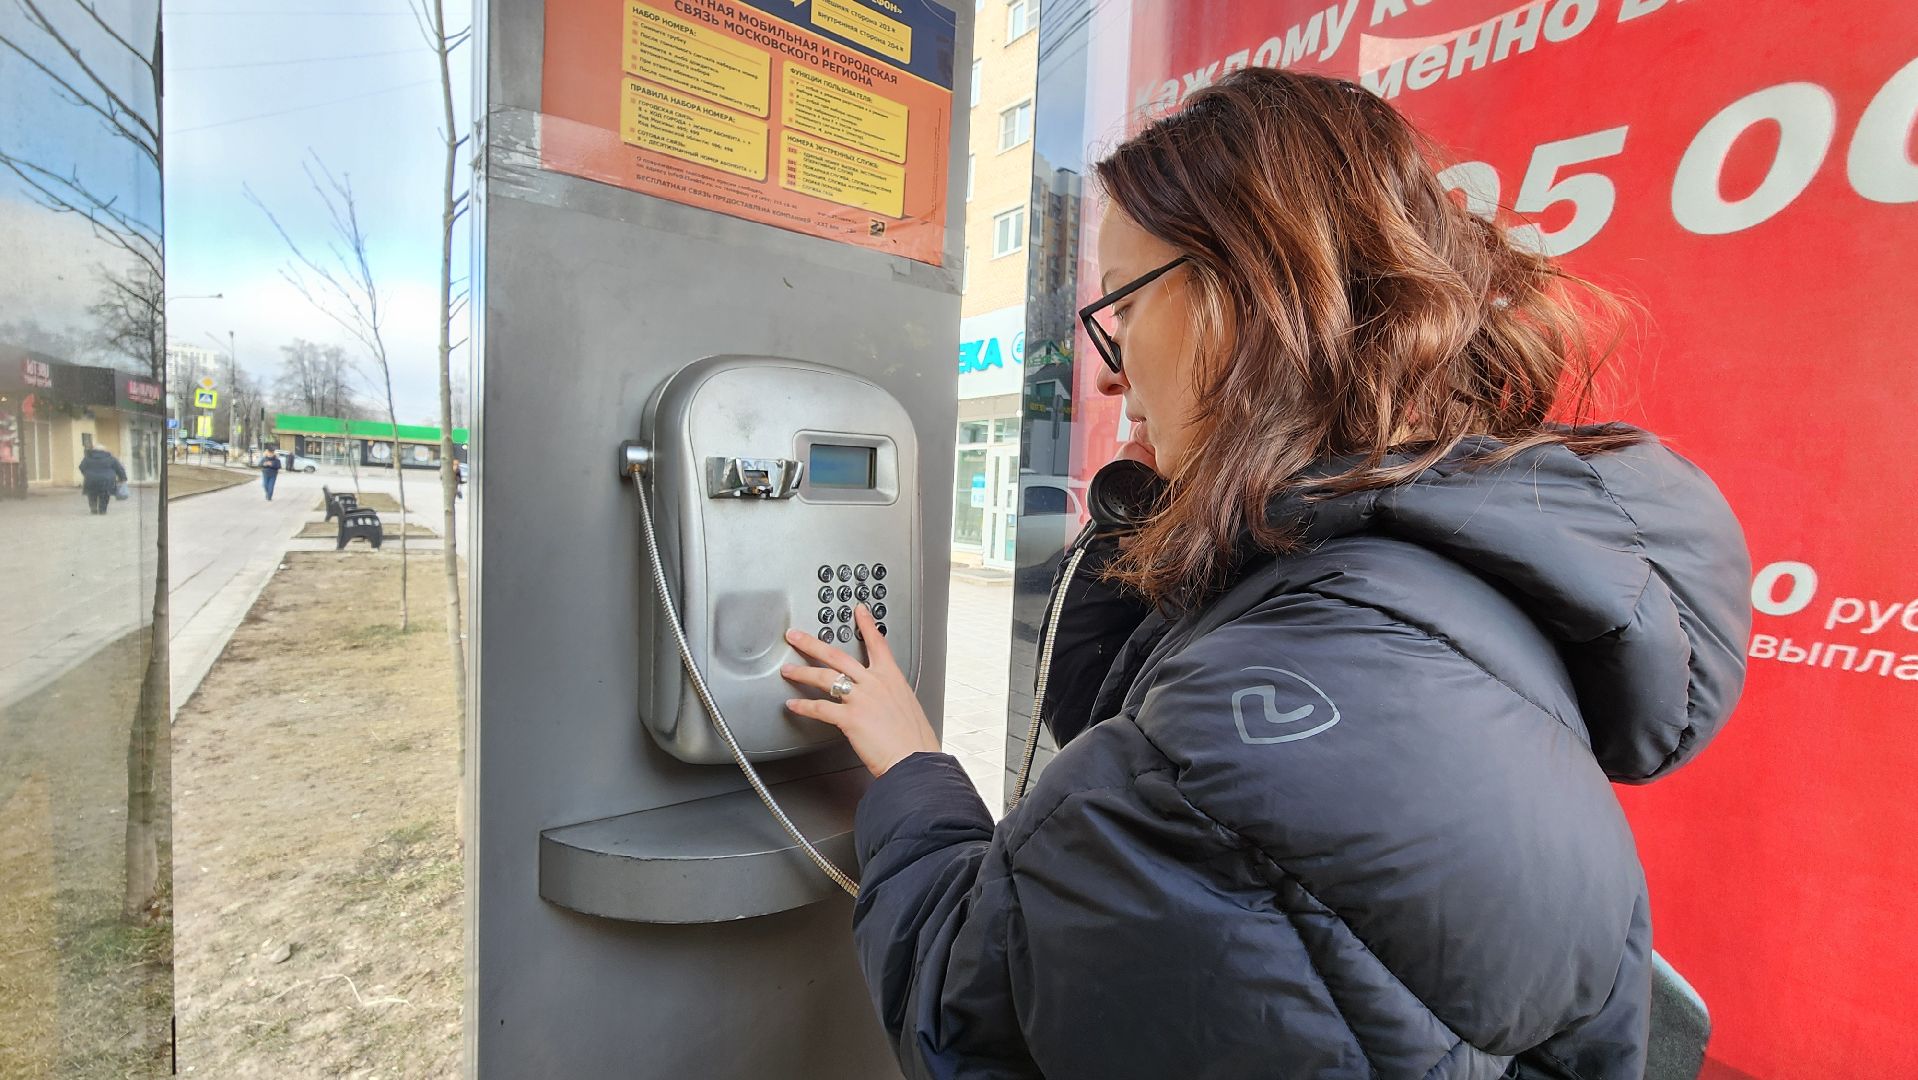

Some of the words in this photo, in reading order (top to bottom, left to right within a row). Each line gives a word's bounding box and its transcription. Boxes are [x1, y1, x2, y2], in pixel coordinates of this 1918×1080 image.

[632, 5, 660, 23] НАБОР
[661, 17, 697, 37] НОМЕРА:
[818, 11, 858, 32] внутренняя
[859, 30, 886, 46] сторона
[850, 10, 877, 25] сторона
[673, 0, 720, 26] СВЯЗЬ
[723, 20, 819, 66] МОСКОВСКОГО
[821, 58, 873, 87] РЕГИОНА
[694, 0, 734, 18] ТНАЯ
[738, 11, 818, 52] МОБИЛЬНАЯ
[821, 45, 831, 58] И
[832, 50, 898, 85] ГОРОДСКАЯ
[1346, 0, 1597, 102] менно
[789, 67, 822, 84] ФУНКЦИИ
[630, 82, 668, 102] ПРАВИЛА
[670, 96, 701, 112] НАБОРА
[702, 106, 735, 123] НОМЕРА:
[786, 134, 814, 148] НОМЕРА
[815, 144, 855, 161] ЭКСТРЕННЫХ
[635, 173, 686, 192] БЕСПЛАТНАЯ
[688, 187, 711, 198] СВЯЗЬ
[712, 193, 770, 214] ПРЕДОСТАВЛЕНА
[771, 209, 811, 224] КОМПАНИЕЙ
